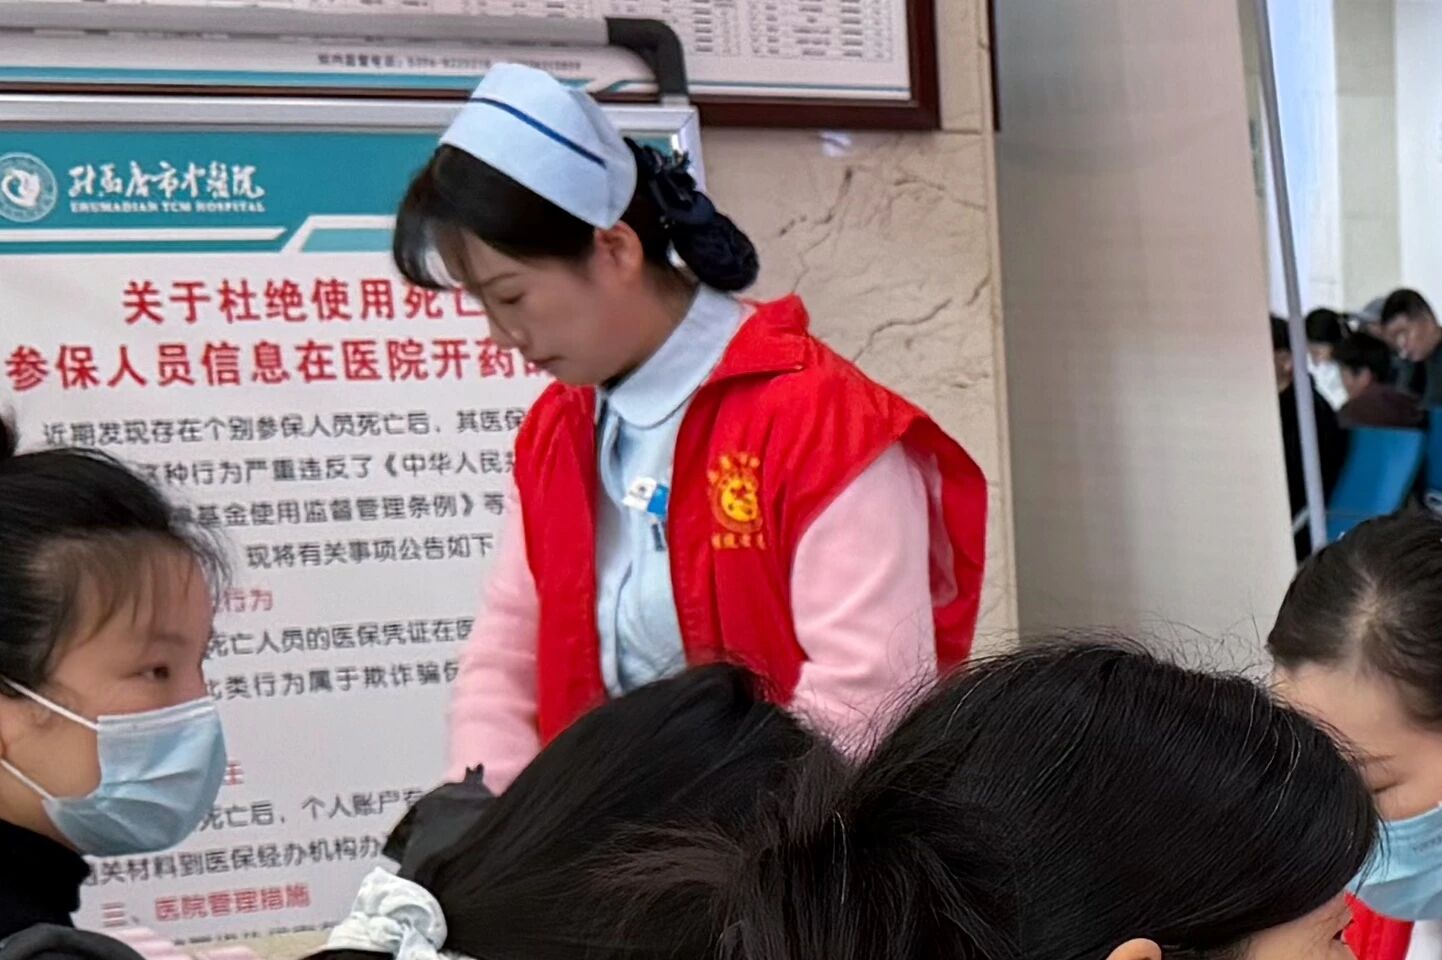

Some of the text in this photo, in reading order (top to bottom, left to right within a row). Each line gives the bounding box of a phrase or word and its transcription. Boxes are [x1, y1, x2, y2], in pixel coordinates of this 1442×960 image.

[162, 201, 192, 213] TCM
[195, 202, 266, 213] HOSPITAL
[217, 588, 274, 613] 行为
